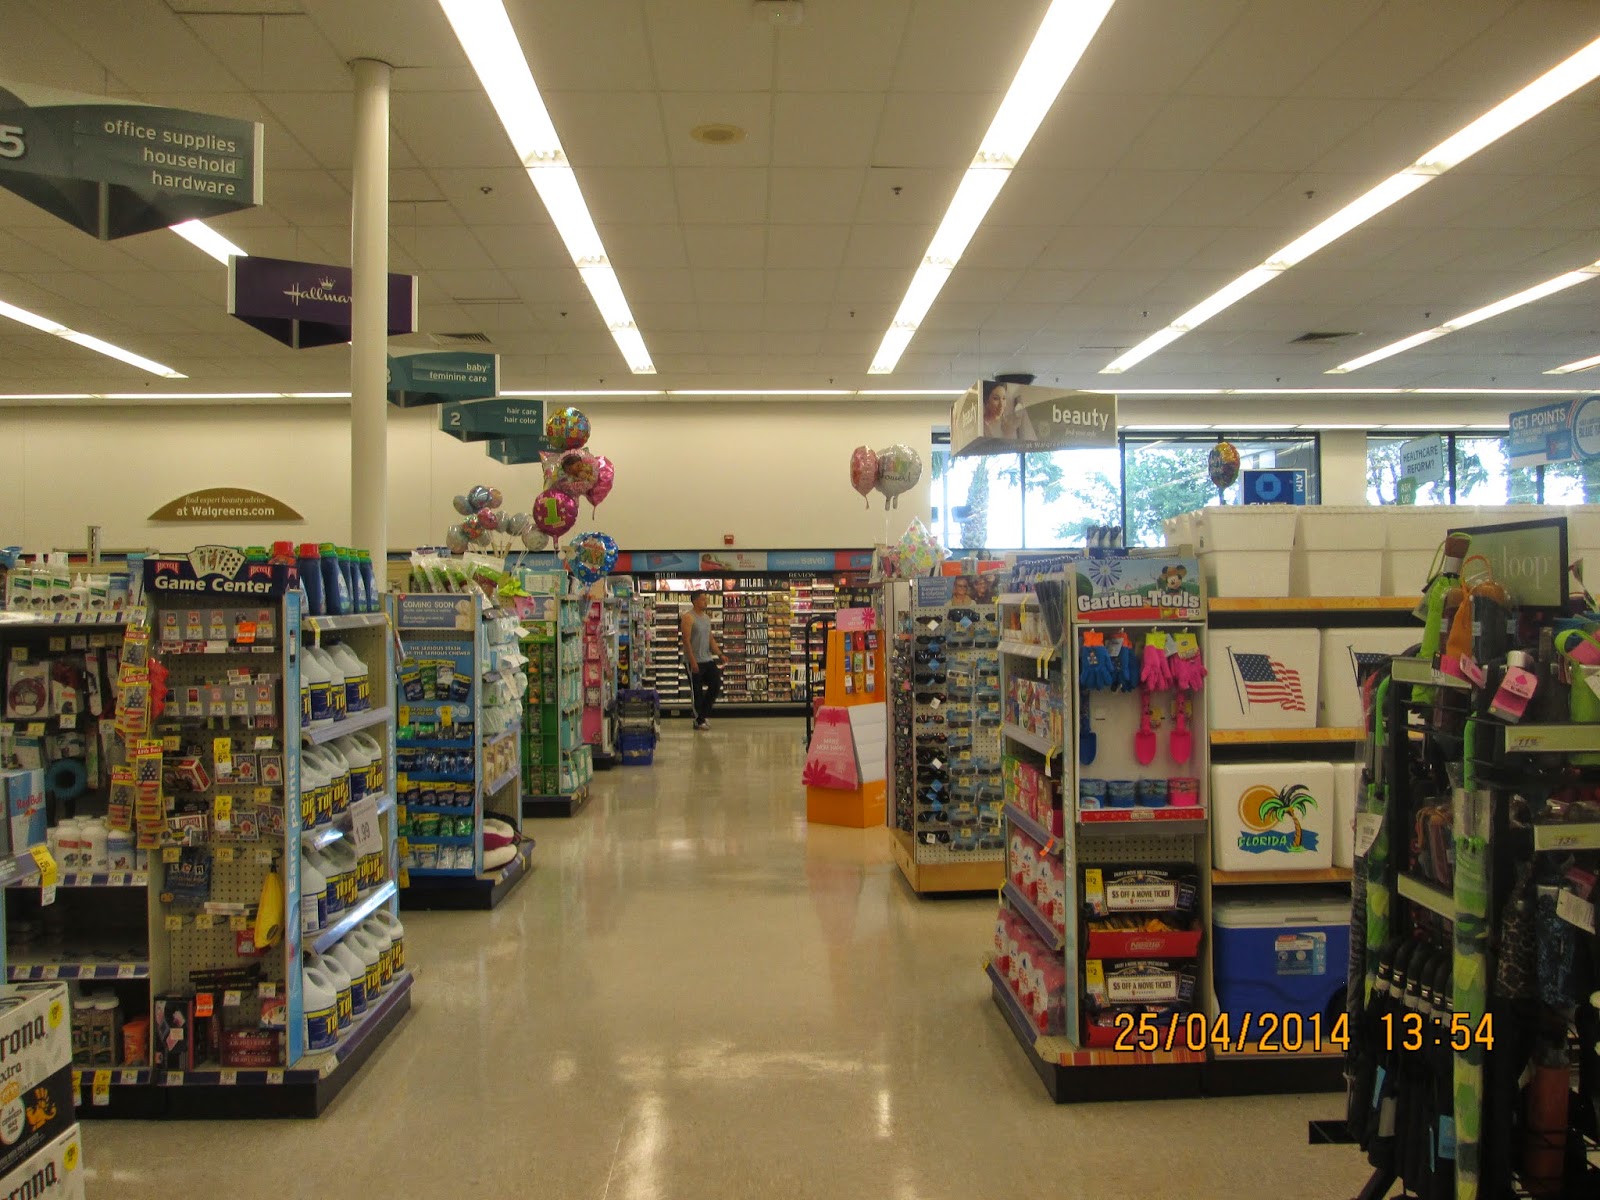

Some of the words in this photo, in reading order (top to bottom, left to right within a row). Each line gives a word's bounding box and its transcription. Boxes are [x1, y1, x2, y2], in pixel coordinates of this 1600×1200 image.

[104, 119, 157, 141] office
[163, 129, 236, 153] supplies
[143, 147, 236, 175] household
[152, 170, 236, 196] hardware
[282, 282, 352, 306] Hallmar
[466, 362, 487, 373] baby
[429, 371, 467, 382] feminine
[468, 375, 488, 383] care
[450, 412, 461, 426] 2
[506, 406, 520, 415] hair
[1052, 403, 1109, 431] beauty
[1512, 414, 1529, 430] GET
[1531, 408, 1567, 427] POINTS
[519, 416, 537, 424] color
[1403, 444, 1439, 463] HEALTHCARE
[1407, 459, 1435, 475] REFORM?
[1295, 473, 1304, 493] ATM
[1399, 482, 1413, 493] ASK
[200, 497, 220, 506] expert
[221, 495, 244, 506] beauty
[244, 496, 267, 504] advice
[176, 507, 188, 516] at
[192, 506, 275, 518] Walgreens.com
[801, 556, 826, 566] save!
[1503, 545, 1549, 590] loop
[155, 562, 181, 575] BICYCLE
[248, 565, 274, 579] BICYCLE
[154, 575, 207, 591] Game
[211, 577, 273, 594] Center
[739, 578, 765, 588] MILANI
[402, 601, 432, 609] COMING
[434, 601, 454, 609] SOON
[1077, 591, 1144, 612] Garden
[1146, 589, 1200, 608] Tools
[287, 752, 301, 829] points
[16, 797, 31, 810] Red
[30, 792, 43, 805] Bull
[1238, 835, 1288, 848] FLORIDA
[287, 835, 300, 893] Earn
[1111, 890, 1120, 899] $5
[1120, 890, 1130, 898] OFF
[1131, 890, 1136, 898] A
[1136, 890, 1152, 898] MOVIE
[1153, 889, 1171, 898] TICKET
[1113, 981, 1121, 990] $5
[1121, 982, 1131, 990] OFF
[1137, 982, 1154, 990] MOVIE
[1155, 980, 1172, 989] TICKET
[0, 1014, 46, 1063] rona
[0, 1062, 22, 1082] xtra
